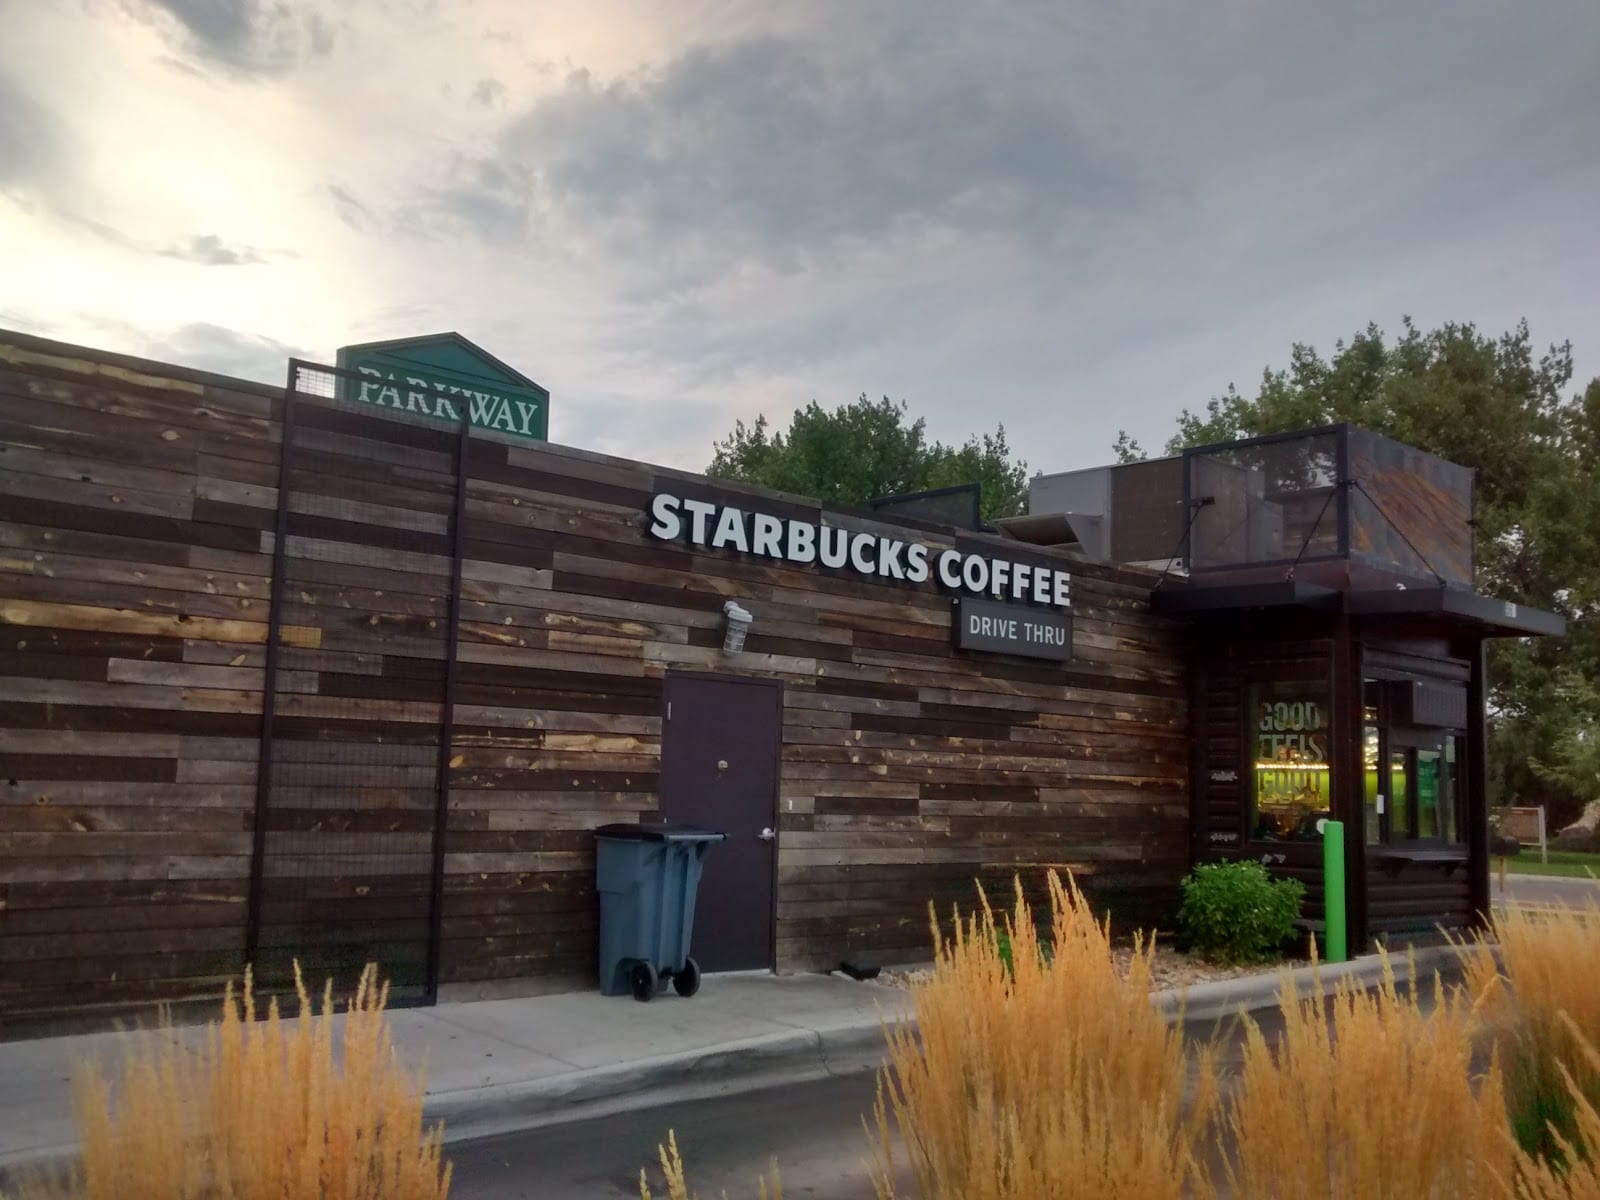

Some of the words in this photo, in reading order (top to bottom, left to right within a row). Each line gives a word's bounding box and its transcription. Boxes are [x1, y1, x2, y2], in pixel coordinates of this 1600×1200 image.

[357, 366, 538, 435] PARKWAY
[650, 493, 928, 583] STARBUCKS
[938, 549, 1071, 607] COFFEE
[970, 615, 1018, 640] DRIVE
[1023, 622, 1066, 646] THRU
[1259, 701, 1321, 731] GOOD
